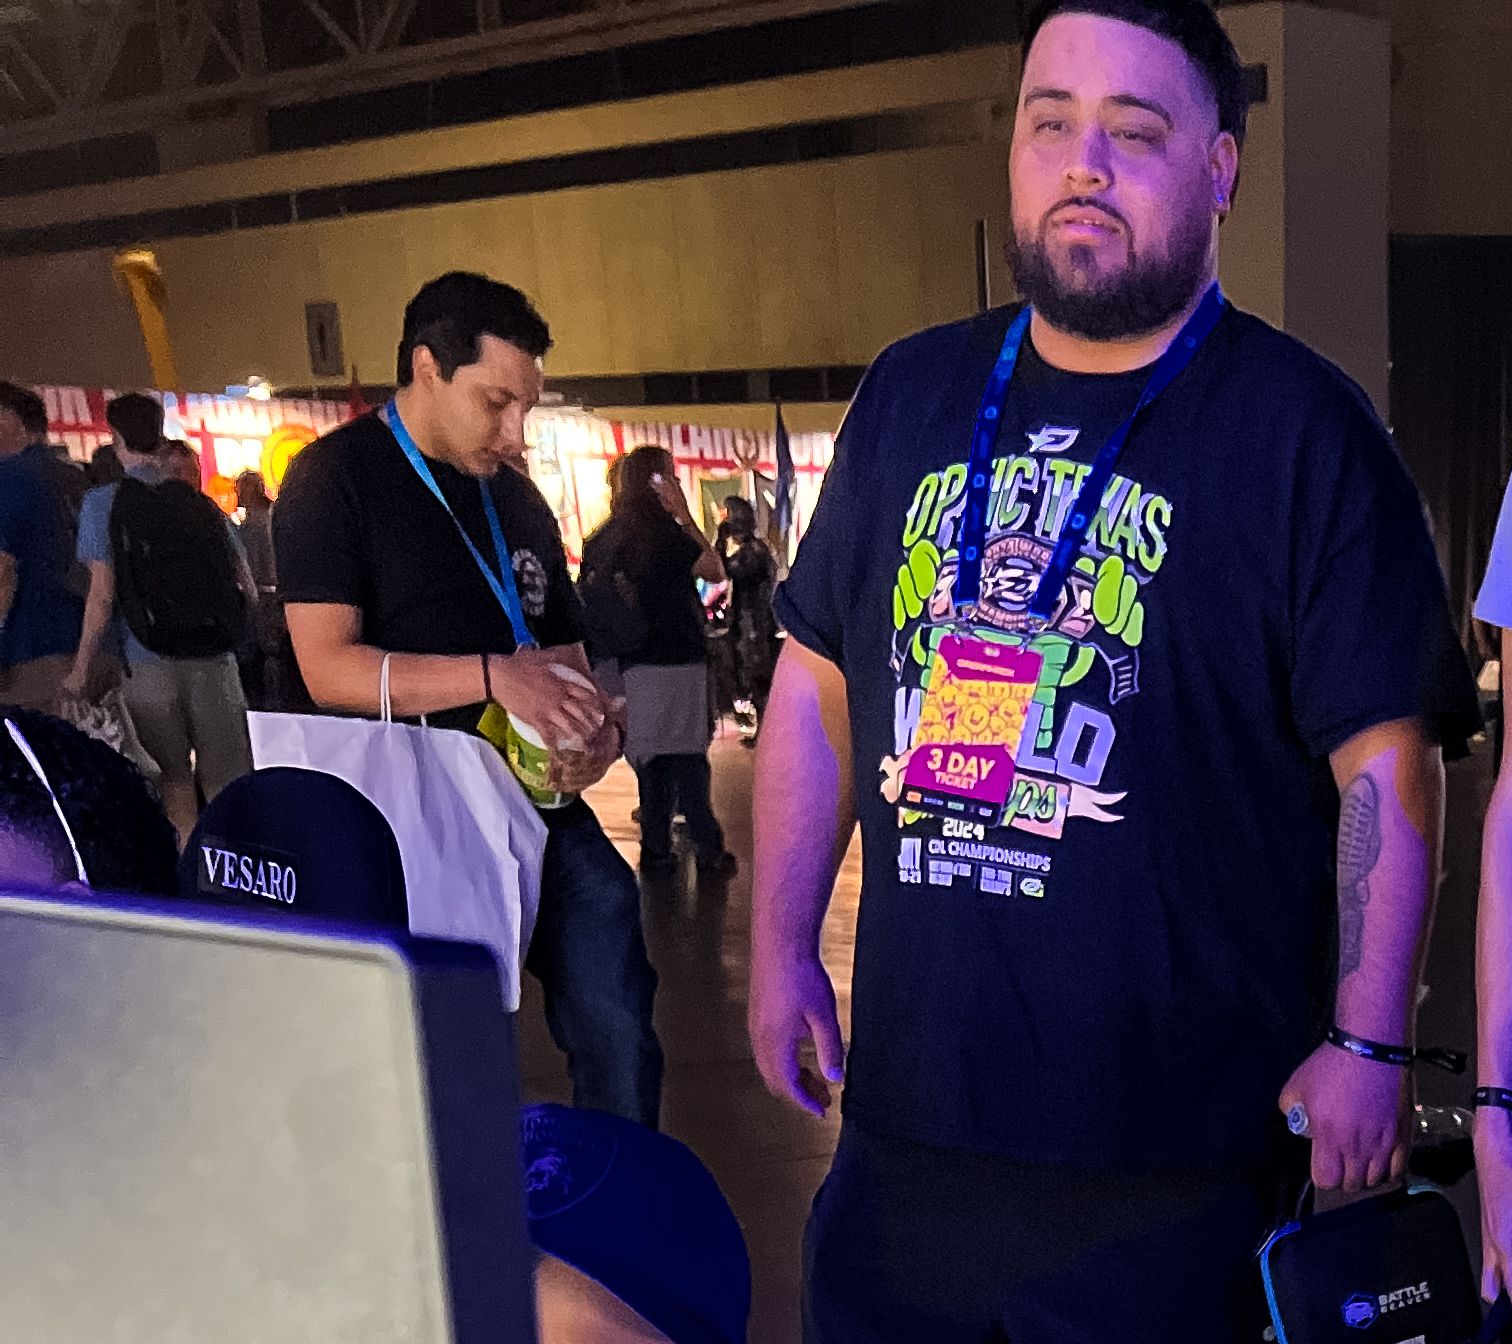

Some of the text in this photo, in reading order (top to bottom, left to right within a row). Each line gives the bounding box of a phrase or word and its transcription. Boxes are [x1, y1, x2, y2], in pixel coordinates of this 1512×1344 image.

[926, 747, 997, 781] 3 DAY
[934, 771, 978, 790] TICKET
[941, 816, 986, 841] 2024
[947, 840, 1052, 872] CHAMPIONSHIPS
[201, 846, 297, 904] VESARO
[1378, 1281, 1429, 1306] BATTLE
